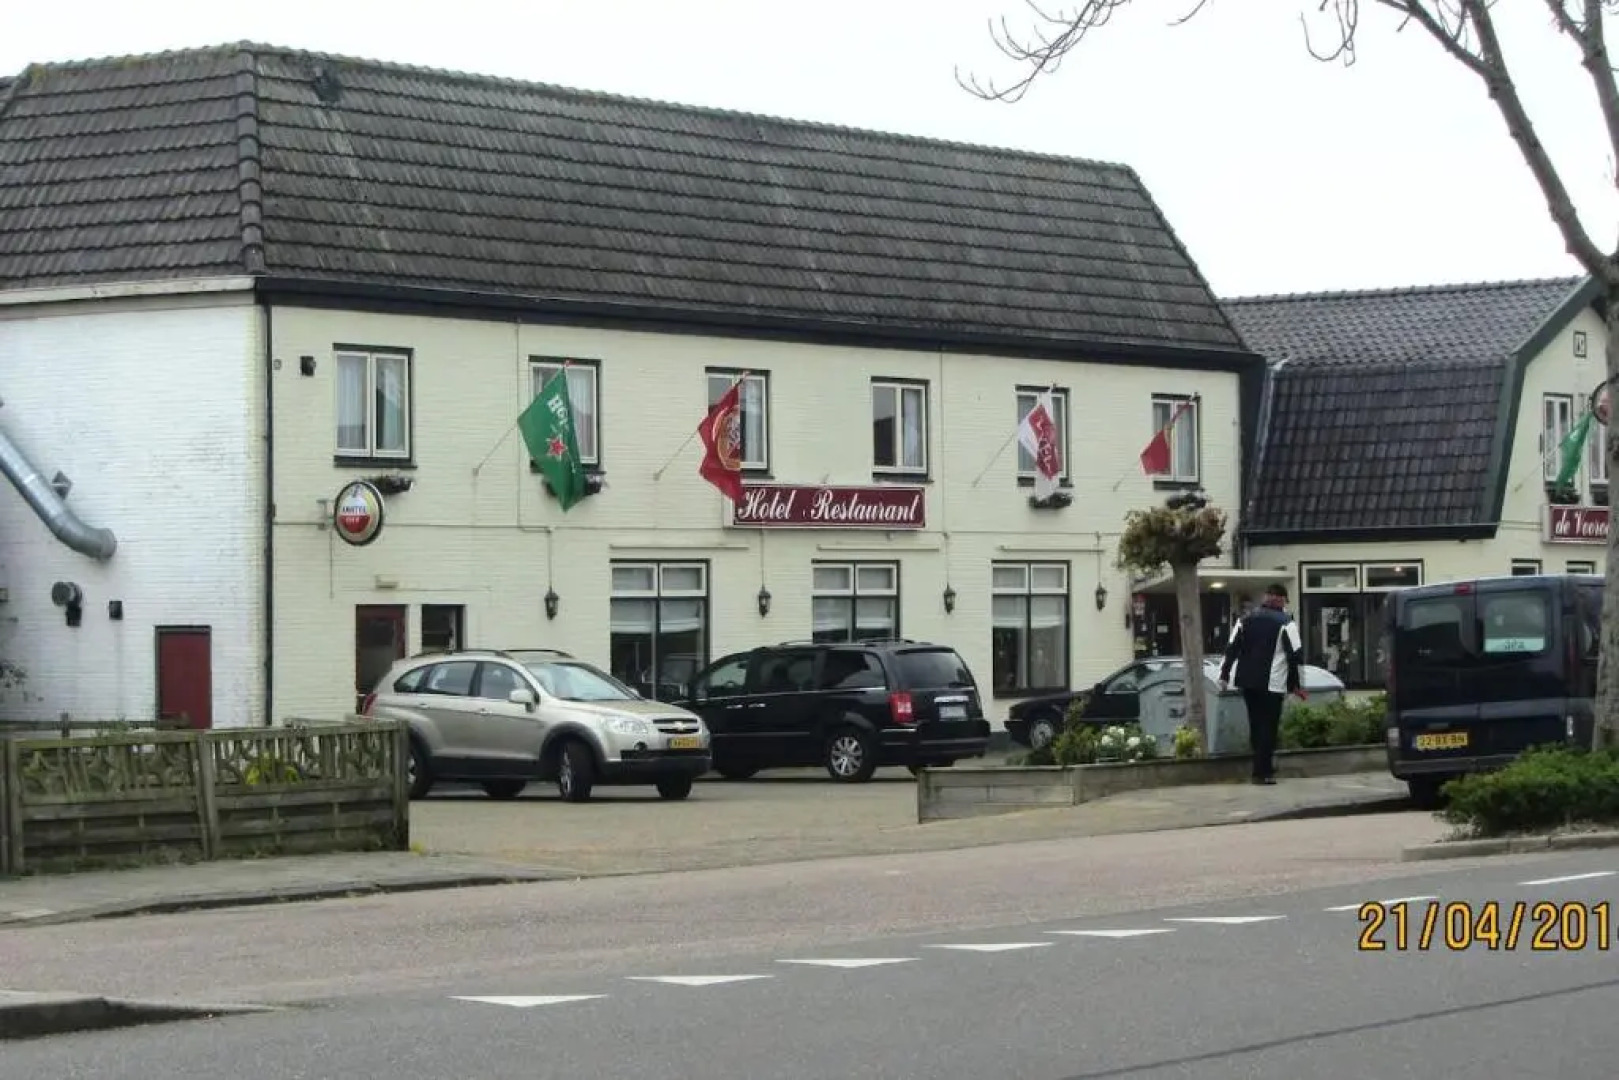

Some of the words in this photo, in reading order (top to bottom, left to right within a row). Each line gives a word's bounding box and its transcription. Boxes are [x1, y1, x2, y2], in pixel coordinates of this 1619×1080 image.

[738, 488, 797, 519] Hotel
[810, 489, 920, 520] Restaurant
[1555, 508, 1571, 535] de
